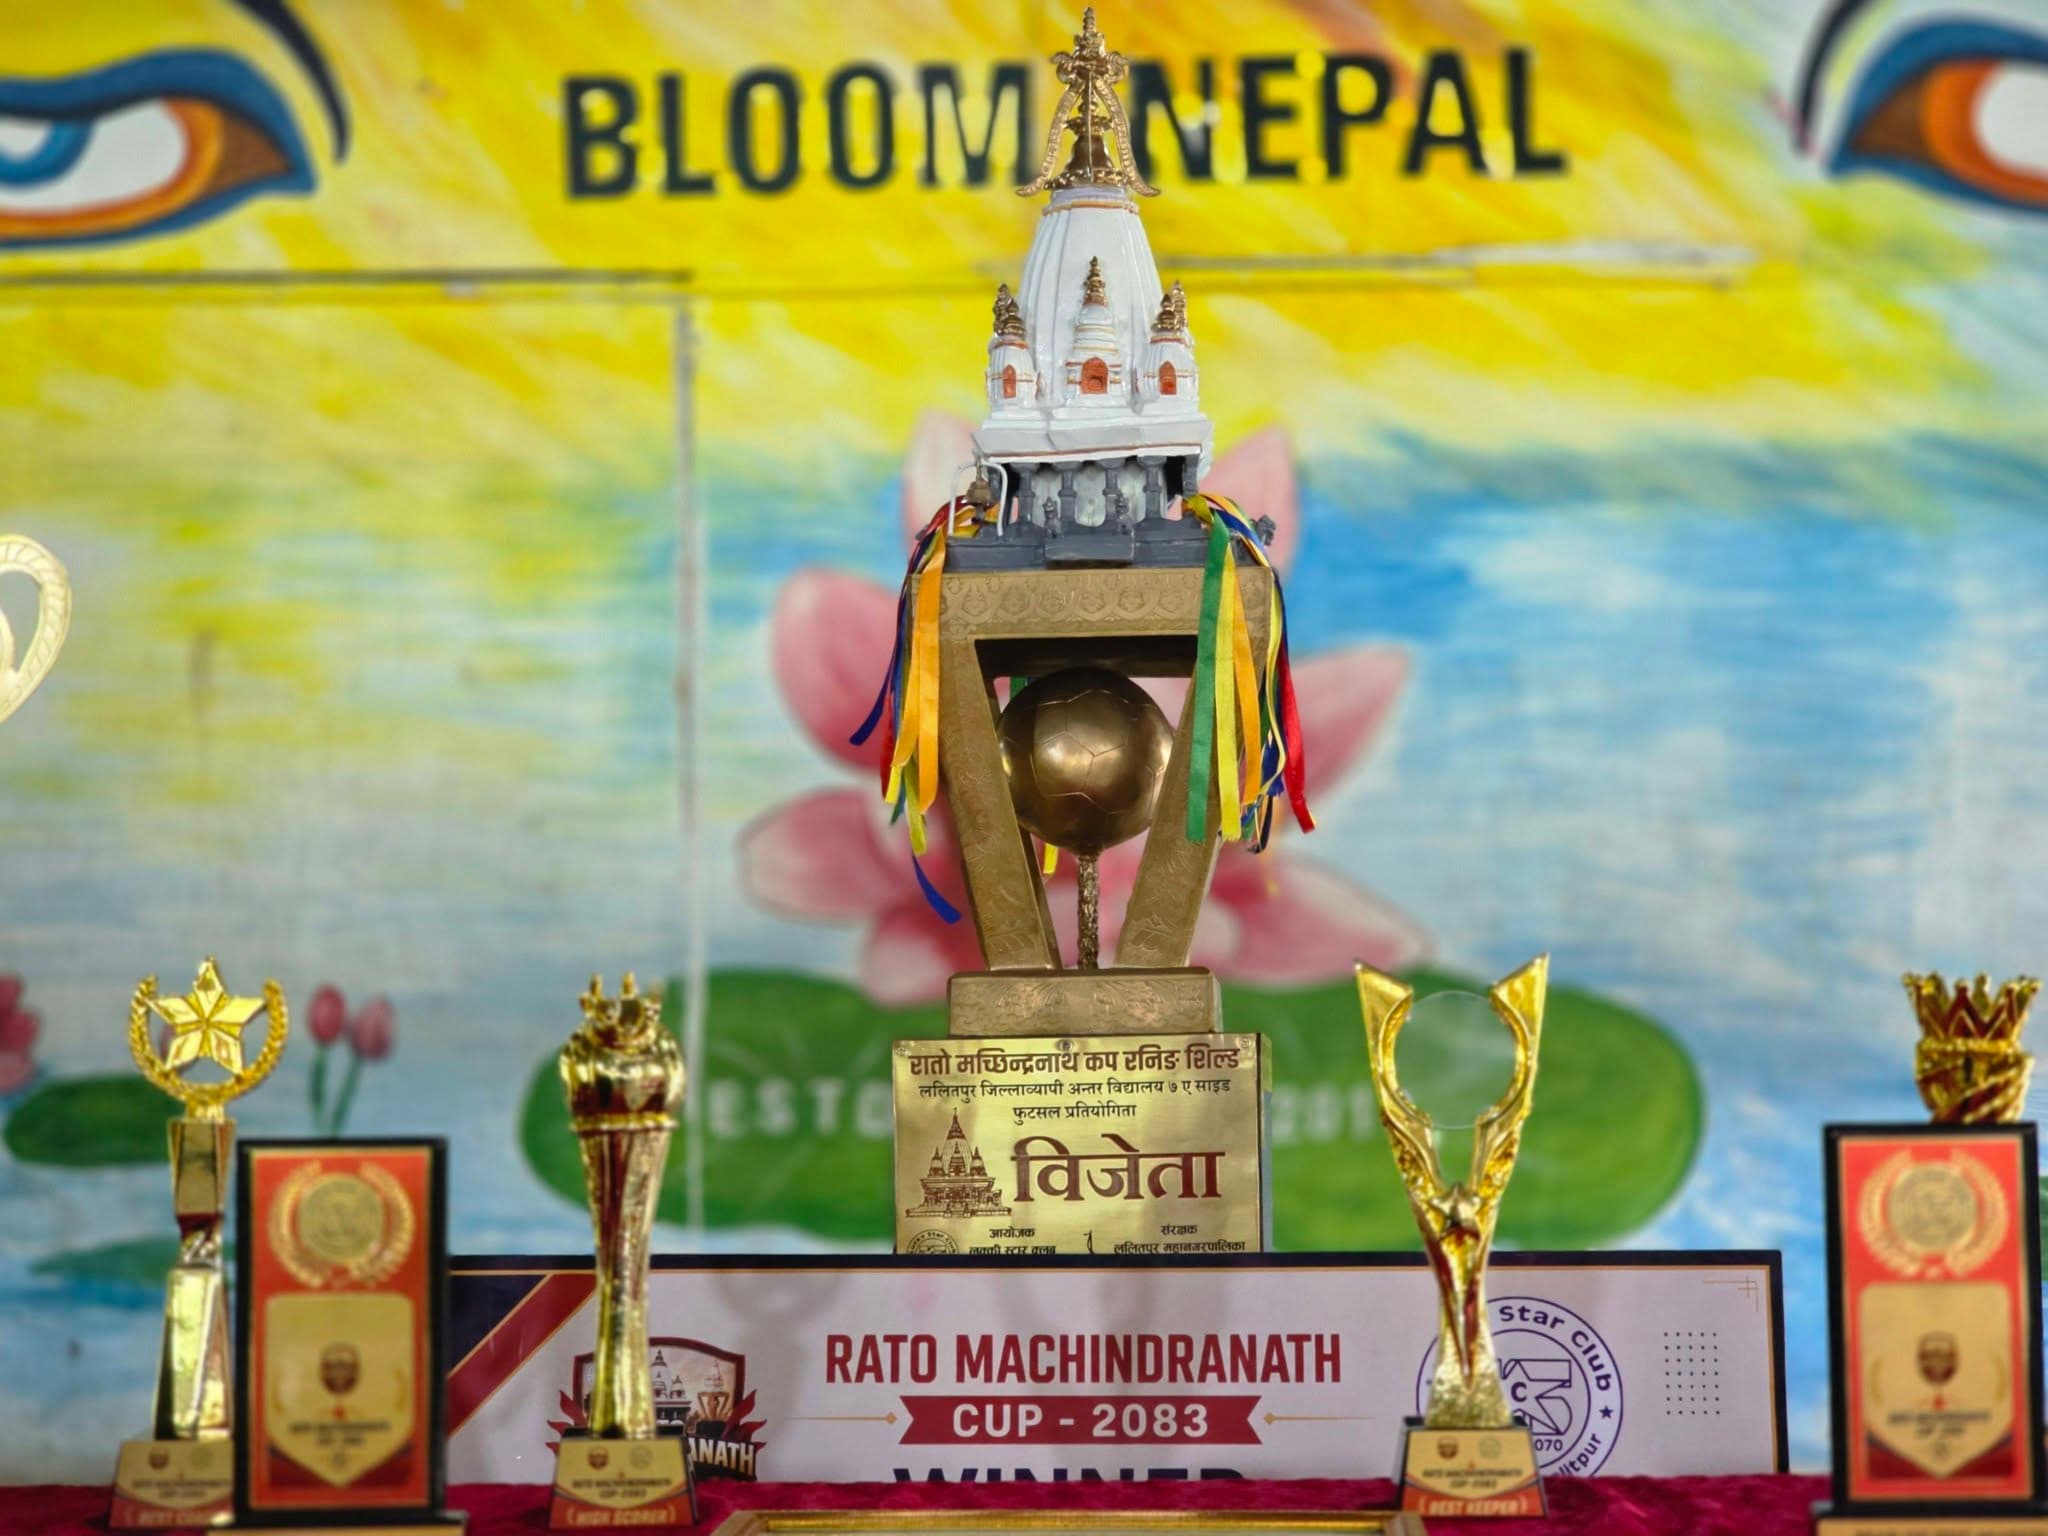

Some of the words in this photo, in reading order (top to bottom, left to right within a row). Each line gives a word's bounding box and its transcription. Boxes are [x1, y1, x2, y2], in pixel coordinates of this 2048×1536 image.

[563, 60, 1031, 198] BLOOM
[1131, 46, 1566, 182] NEPAL
[908, 1048, 952, 1076] रातो
[1084, 1051, 1118, 1072] कप
[1122, 1044, 1181, 1072] रनिङ
[1185, 1043, 1241, 1070] शिल्ड
[918, 1080, 977, 1104] ललितपुर
[980, 1079, 1065, 1097] जिल्लाव्यापी
[1068, 1082, 1103, 1096] अन्तर
[1107, 1077, 1165, 1095] विद्यालय
[1168, 1082, 1178, 1094] ७
[1182, 1080, 1193, 1095] ए
[1195, 1079, 1232, 1095] साइड
[1012, 1105, 1061, 1126] फुटसल
[1064, 1099, 1137, 1119] प्रतियोगिता
[1010, 1133, 1226, 1202] विजेता
[989, 1226, 1035, 1239] आयोजक
[1160, 1223, 1199, 1236] संरक्षक
[826, 1333, 938, 1383] RATO
[955, 1333, 1342, 1383] MACHINDRANATH
[1498, 1304, 1565, 1330] Star
[1570, 1329, 1613, 1392] Club
[952, 1403, 1044, 1438] CUP
[1091, 1403, 1209, 1438] 2083
